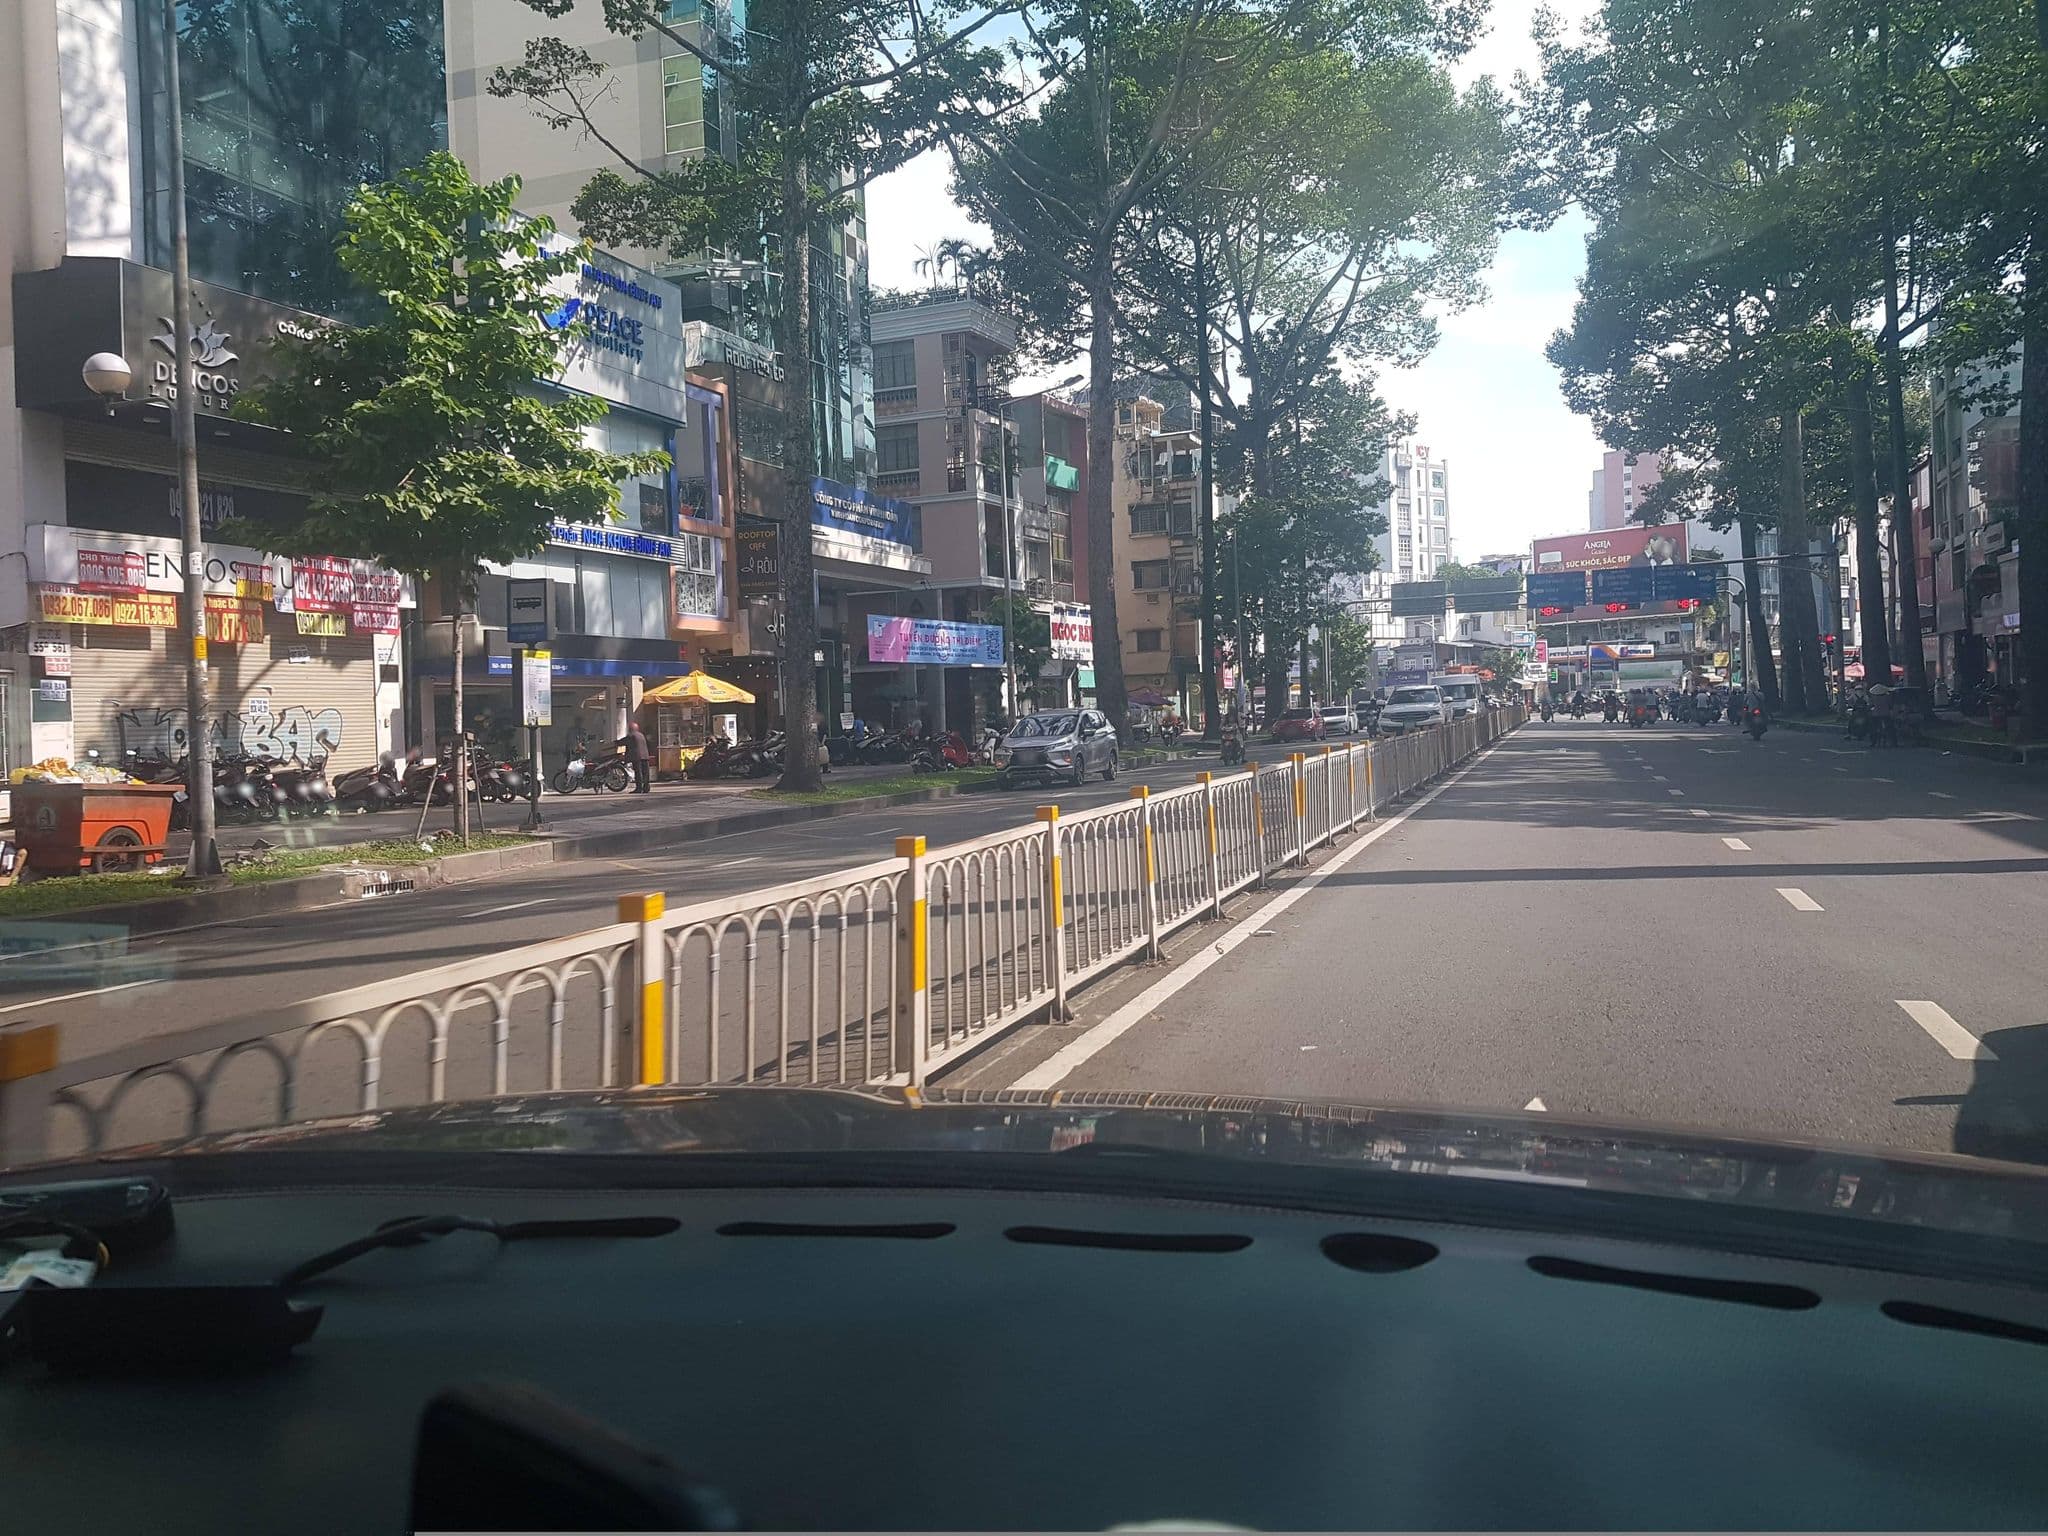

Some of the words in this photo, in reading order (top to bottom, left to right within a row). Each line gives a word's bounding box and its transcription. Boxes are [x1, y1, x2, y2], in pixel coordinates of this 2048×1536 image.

[584, 302, 643, 345] PEACE
[813, 490, 833, 505] CÔNG
[582, 528, 604, 545] NHA
[606, 532, 632, 550] KHOA
